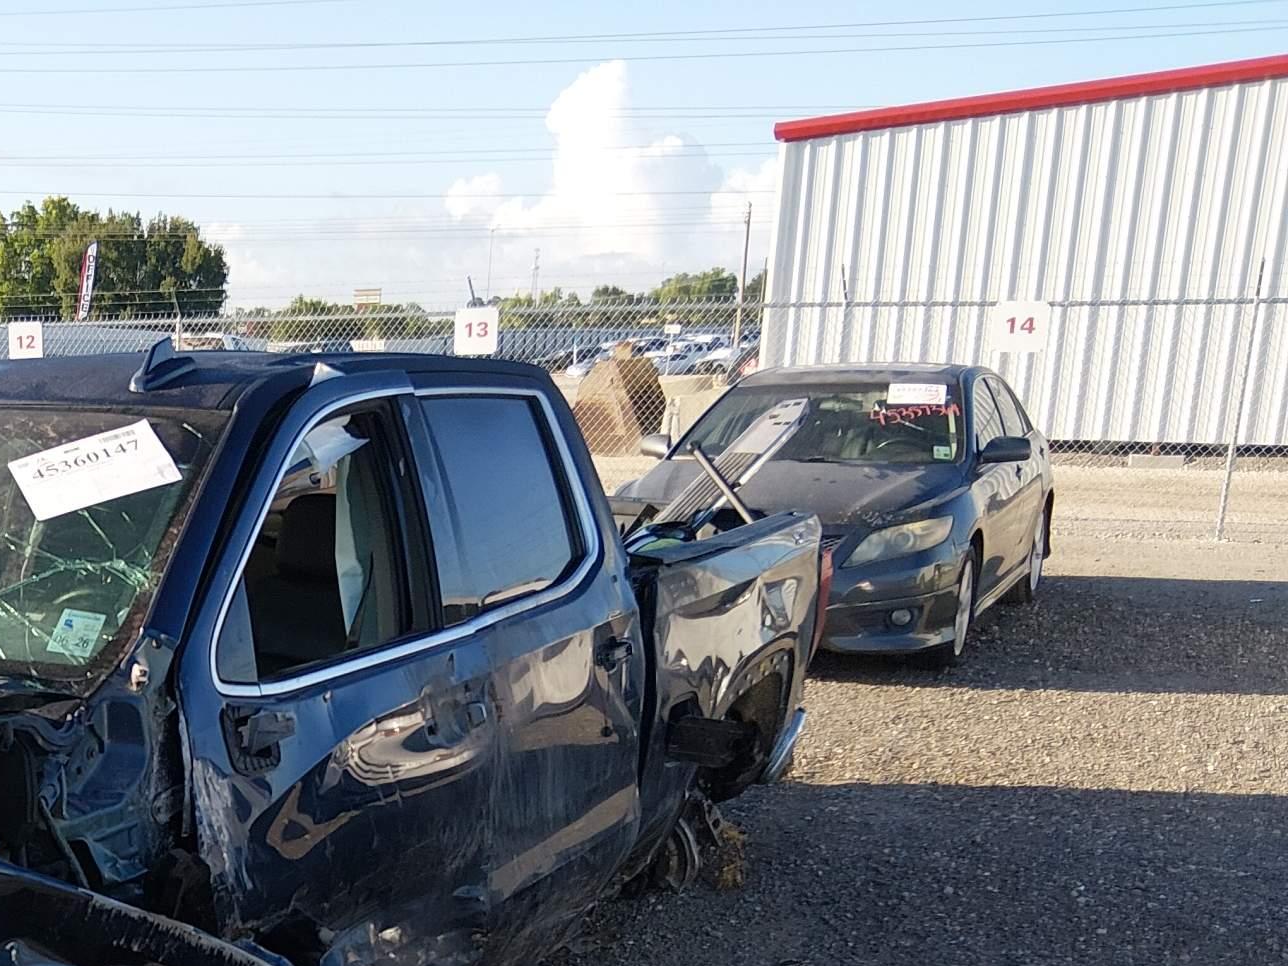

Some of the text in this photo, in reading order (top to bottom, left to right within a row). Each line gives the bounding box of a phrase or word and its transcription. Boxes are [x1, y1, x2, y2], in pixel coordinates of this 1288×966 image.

[80, 254, 96, 313] OFFICE
[464, 321, 489, 338] 13
[1006, 316, 1036, 334] 14
[16, 335, 36, 350] 12
[32, 439, 139, 480] 45360147
[72, 636, 90, 649] 26
